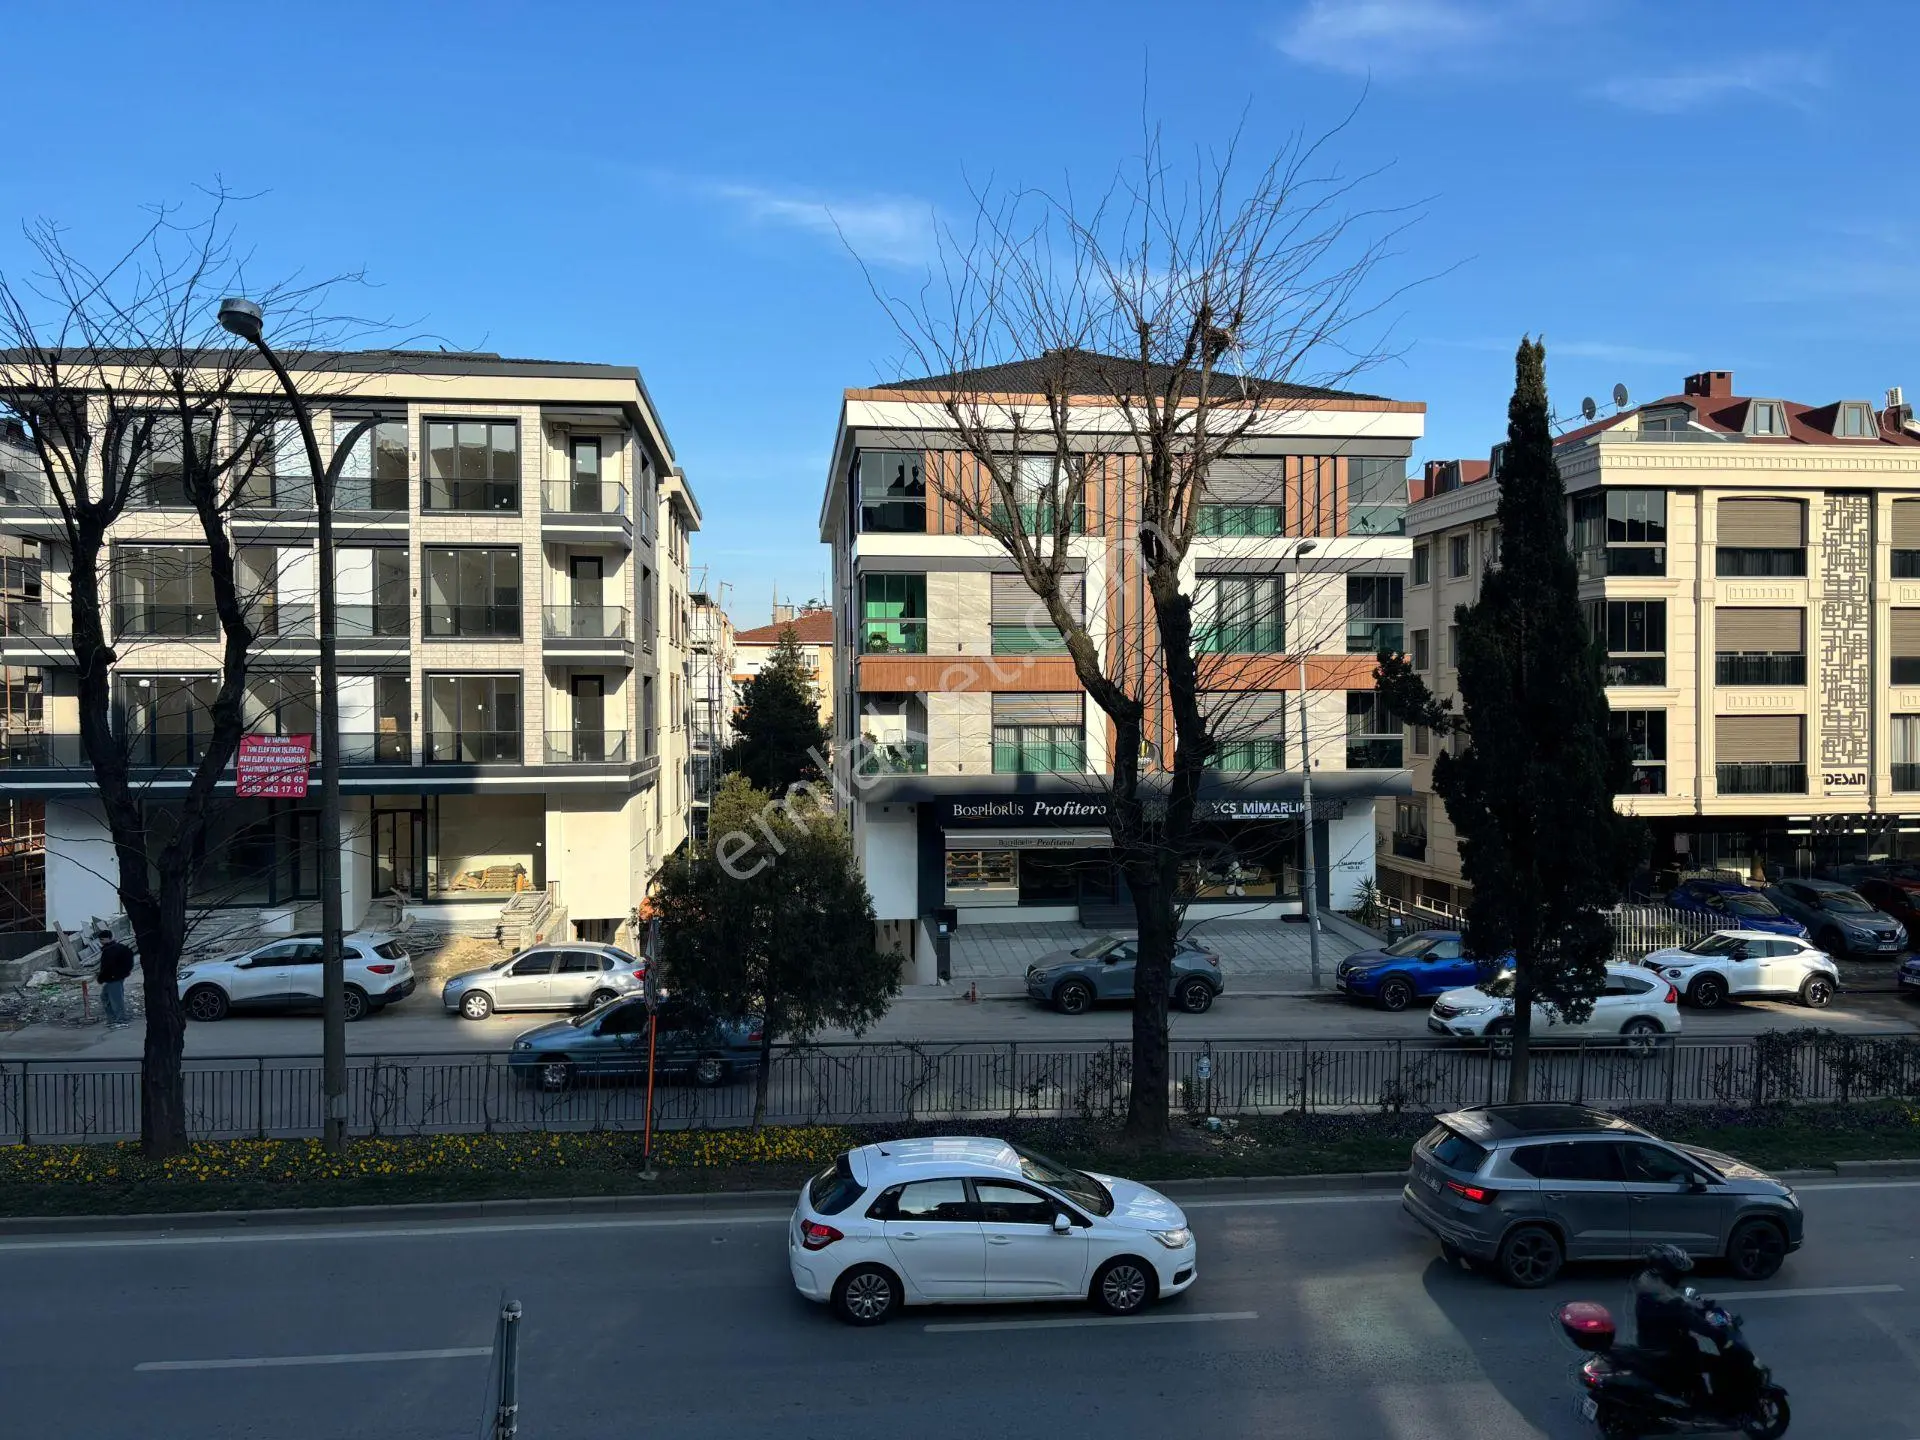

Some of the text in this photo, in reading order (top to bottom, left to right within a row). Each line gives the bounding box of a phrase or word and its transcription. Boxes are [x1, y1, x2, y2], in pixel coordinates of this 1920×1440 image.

[263, 785, 279, 793] 443
[281, 785, 291, 793] 17
[1032, 801, 1107, 816] Profitero
[1212, 800, 1306, 814] YCS MİMARLIK
[1811, 814, 1899, 836] KOPUZ
